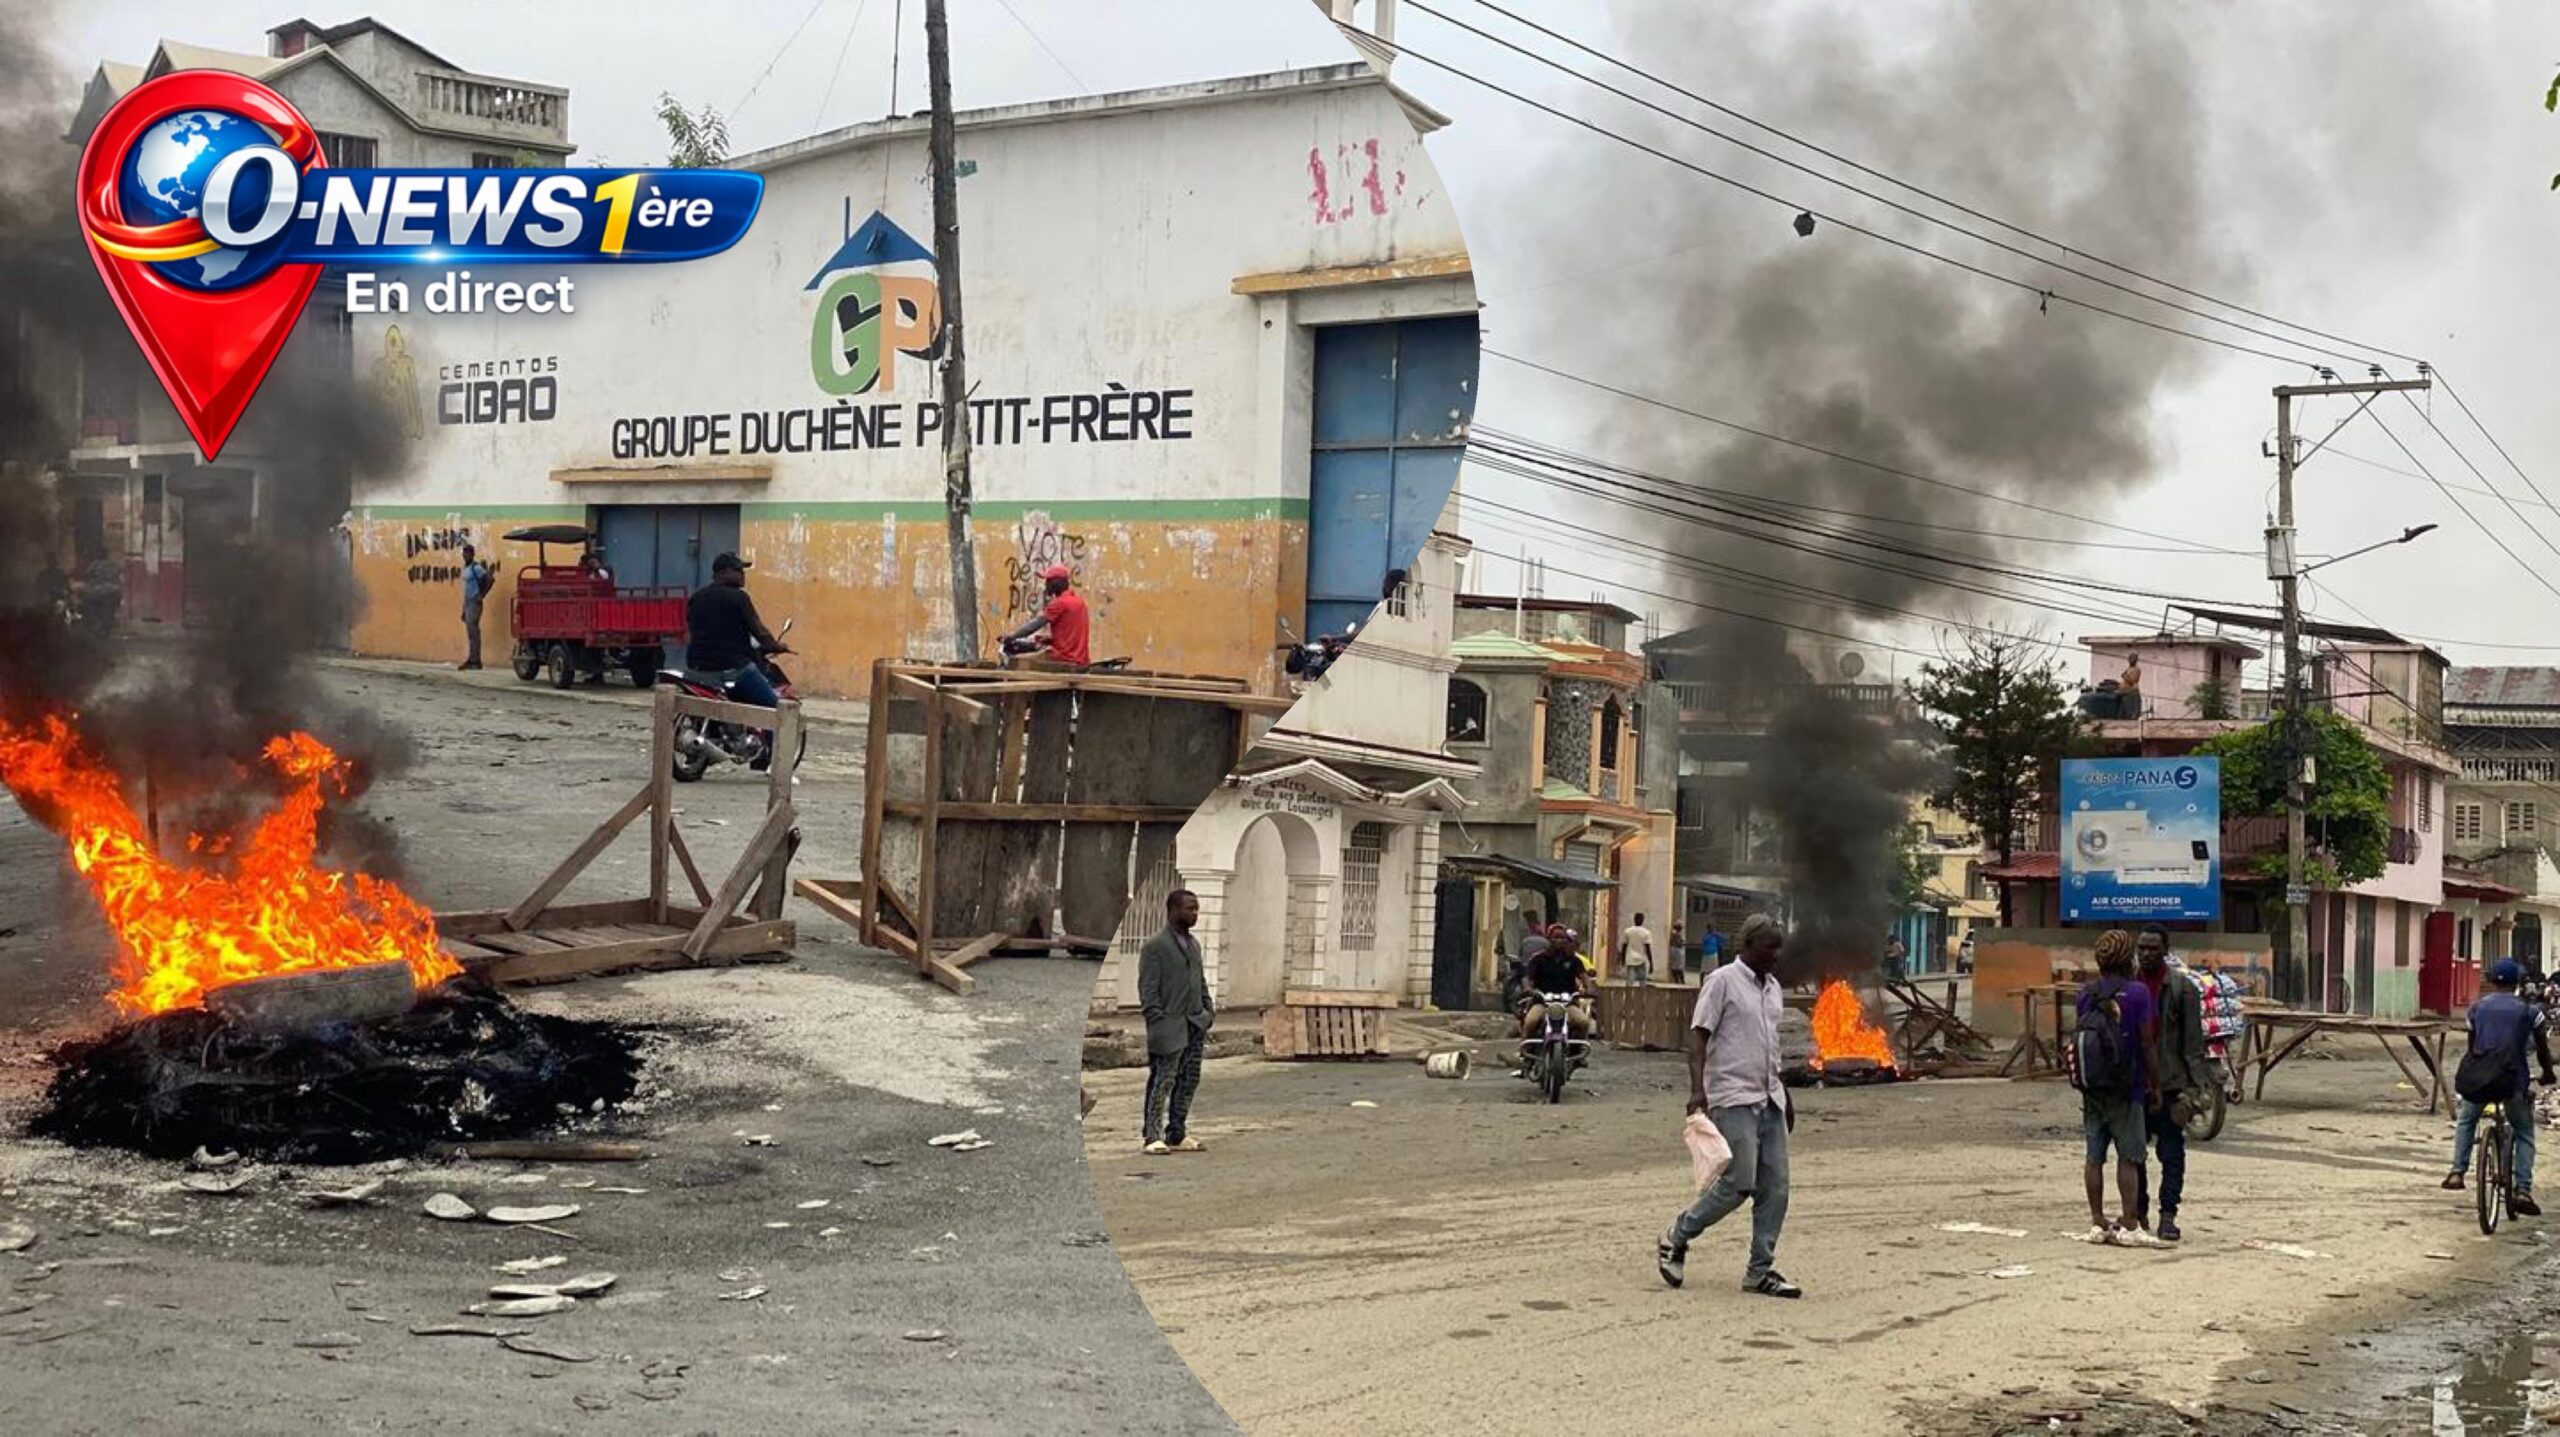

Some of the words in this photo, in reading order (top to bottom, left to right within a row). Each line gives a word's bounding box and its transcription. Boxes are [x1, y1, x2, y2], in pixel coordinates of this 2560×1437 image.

[811, 273, 943, 396] GP
[440, 356, 558, 381] CEMENTOS
[438, 375, 558, 425] CIBAO
[611, 413, 732, 459] GROUPE
[740, 398, 902, 454] DUCHÈNE
[915, 382, 1193, 448] PTIT-FRÈRE
[2091, 896, 2110, 906] AIR
[2111, 896, 2181, 906] CONDITIONER
